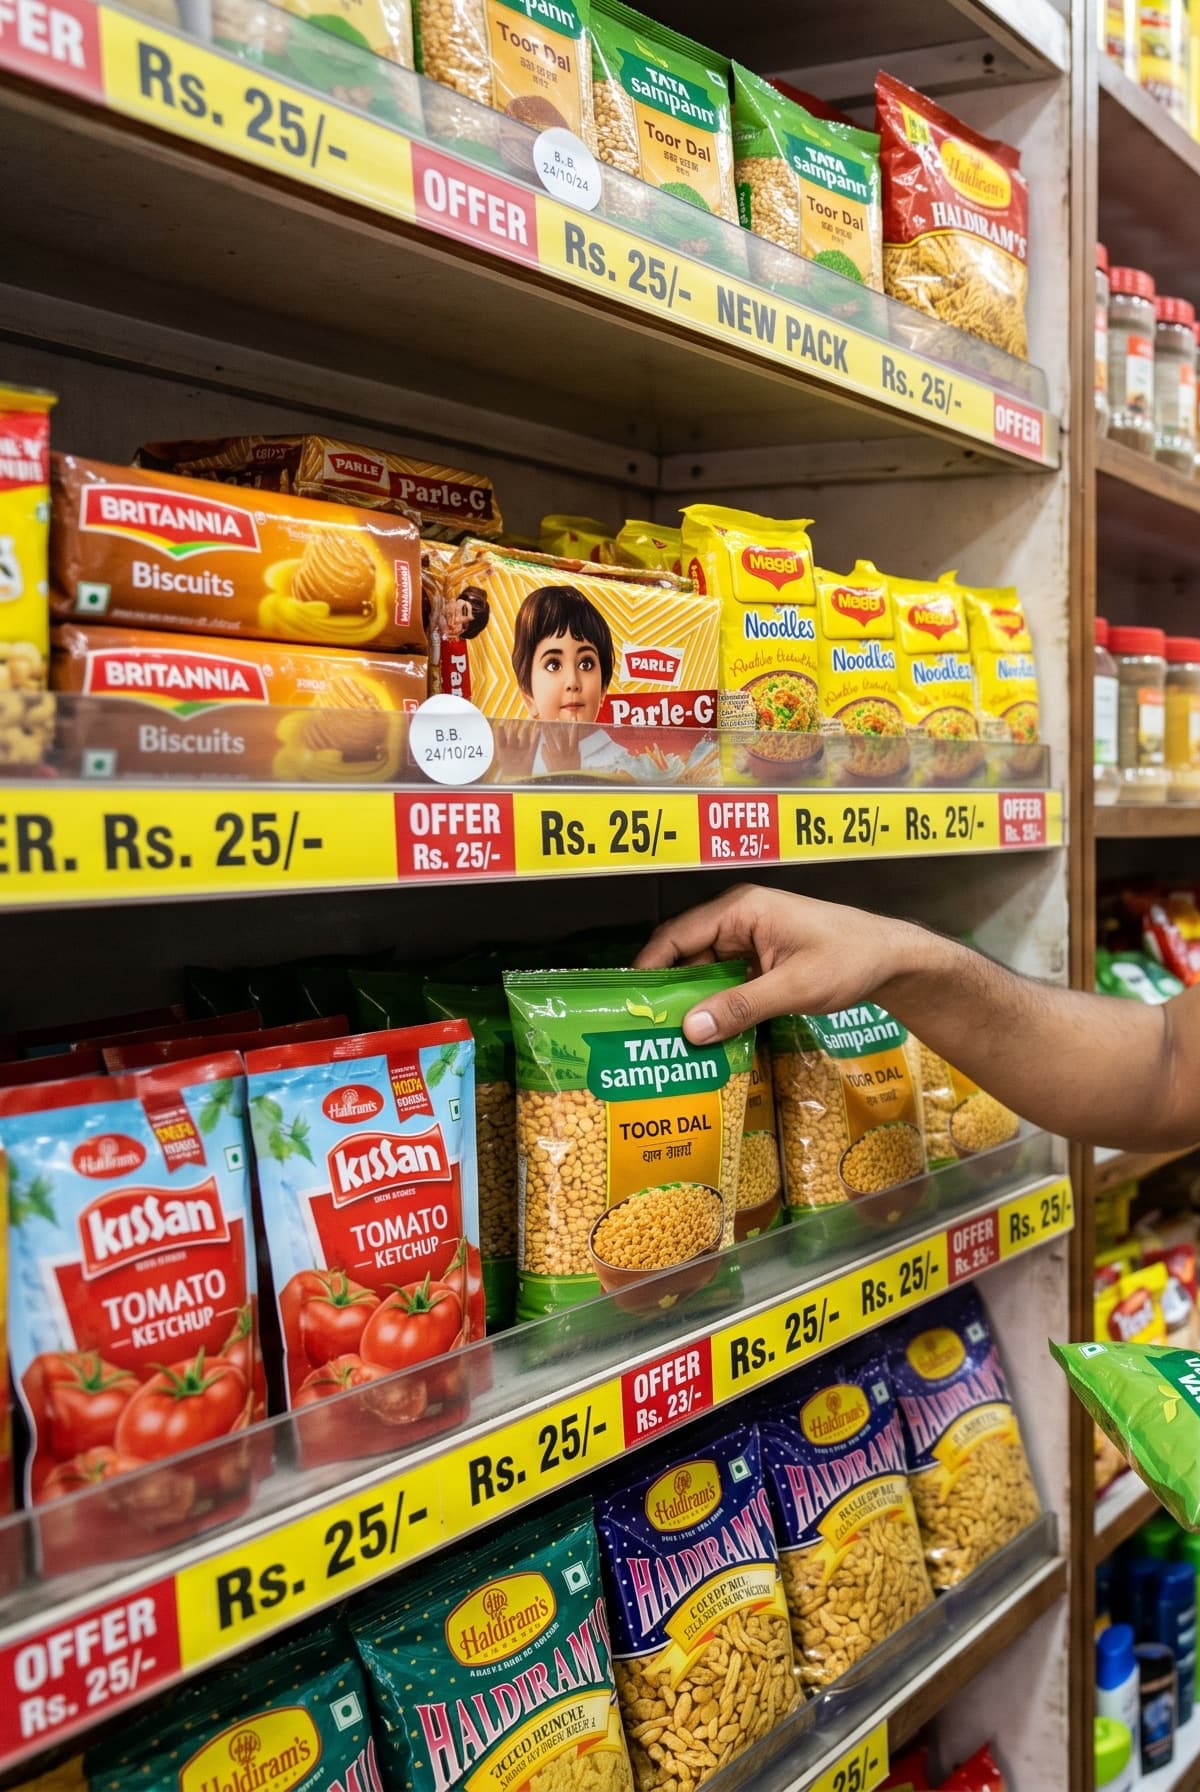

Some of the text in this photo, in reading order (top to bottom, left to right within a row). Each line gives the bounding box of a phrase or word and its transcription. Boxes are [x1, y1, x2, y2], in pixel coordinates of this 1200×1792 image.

[496, 21, 540, 56] Toor
[631, 76, 713, 124] sampann
[646, 67, 690, 99] TATA
[138, 40, 223, 127] Rs.
[247, 89, 348, 168] 25/-
[644, 120, 711, 162] Toor Dal
[543, 162, 589, 192] 24/10/24
[794, 155, 867, 198] sampann
[805, 146, 847, 174] TATA
[807, 196, 864, 231] Toor Dal
[931, 201, 1027, 259] HALDIRAM'S
[423, 168, 1041, 446] OFFER Rs. 25/- NEW PACK Rs. 25/- OFFER
[336, 457, 379, 477] PARLE
[398, 478, 486, 511] Parle-G
[100, 495, 242, 538] BRITANNIA
[132, 560, 235, 598] Biscuits
[749, 554, 798, 573] Maggi
[745, 611, 815, 639] Noodles
[104, 660, 250, 692] BRITANNIA
[630, 657, 675, 673] PARLE
[832, 646, 895, 671] Noodles
[610, 695, 714, 727] Parle-G
[138, 724, 245, 754] Biscuits
[424, 746, 483, 762] 24/10/24
[410, 803, 501, 836] OFFER
[708, 802, 770, 830] OFFER
[795, 805, 985, 847] Rs. 25/- Rs. 25/-
[1003, 798, 1042, 820] OFFER
[104, 813, 192, 870] Rs.
[214, 810, 323, 871] 25/-
[541, 808, 677, 857] Rs. 25/-
[711, 834, 770, 857] Rs. 25/-
[413, 841, 500, 870] Rs. 25/-
[828, 1006, 874, 1030] TATA
[624, 1037, 688, 1063] TATA
[825, 1022, 900, 1052] sampann
[600, 1058, 718, 1093] sampann
[875, 1069, 904, 1085] DAL
[619, 1113, 712, 1141] TOOR DAL
[350, 1204, 448, 1252] TOMATO
[1010, 1189, 1071, 1244] Rs. 25/-
[375, 1236, 439, 1269] KETCHUP
[953, 1218, 994, 1253] OFFER
[102, 1269, 226, 1331] TOMATO
[730, 1250, 939, 1381] Rs. 25/- Rs. 25/-
[132, 1306, 214, 1349] KETCHUP
[633, 1350, 701, 1404] OFFER
[636, 1384, 702, 1434] Rs. 23/-
[216, 1405, 607, 1632] Rs. 25/- Rs. 25/-
[14, 1597, 157, 1693] OFFER
[460, 1595, 549, 1661] Haldiram's
[19, 1648, 157, 1739] Rs. 25/-
